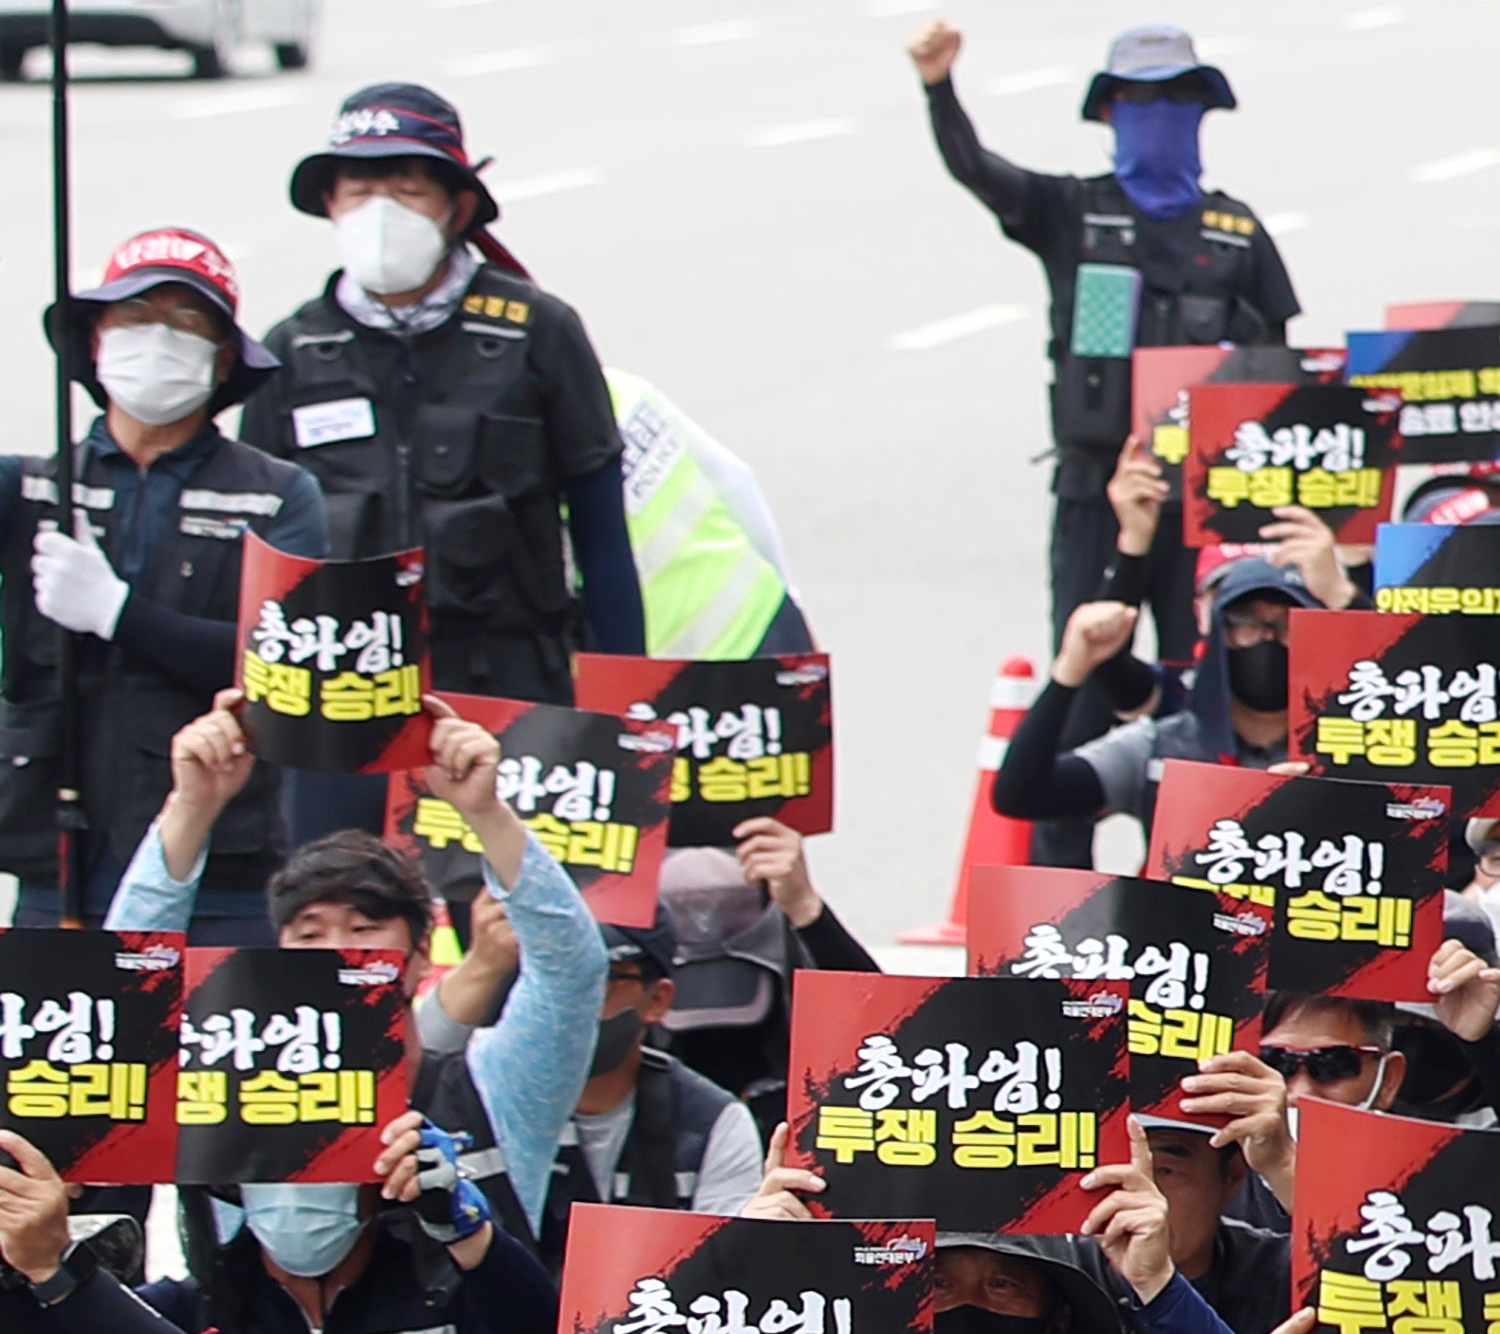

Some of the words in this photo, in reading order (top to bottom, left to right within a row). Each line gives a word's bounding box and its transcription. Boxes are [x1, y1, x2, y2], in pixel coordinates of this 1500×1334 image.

[1226, 421, 1363, 473] 총파업!
[1207, 467, 1293, 507] 투쟁
[1297, 467, 1382, 509] 승리!
[253, 600, 401, 672] 총파업!
[245, 655, 310, 715] 투쟁
[320, 665, 420, 720] 승리!
[1317, 717, 1416, 766] 투쟁
[498, 757, 614, 824] 파업!
[698, 753, 809, 801] 승리!
[1196, 821, 1382, 895] 총파업!
[1287, 890, 1411, 946] 승리!
[1012, 925, 1208, 1010] 총파업!
[1129, 1001, 1232, 1061] 승리!
[7, 1060, 146, 1119] 승리!
[239, 1070, 374, 1124] 승리!
[845, 1036, 1060, 1113] 총파업!
[819, 1106, 936, 1165] 투쟁
[952, 1111, 1095, 1168] 승리!
